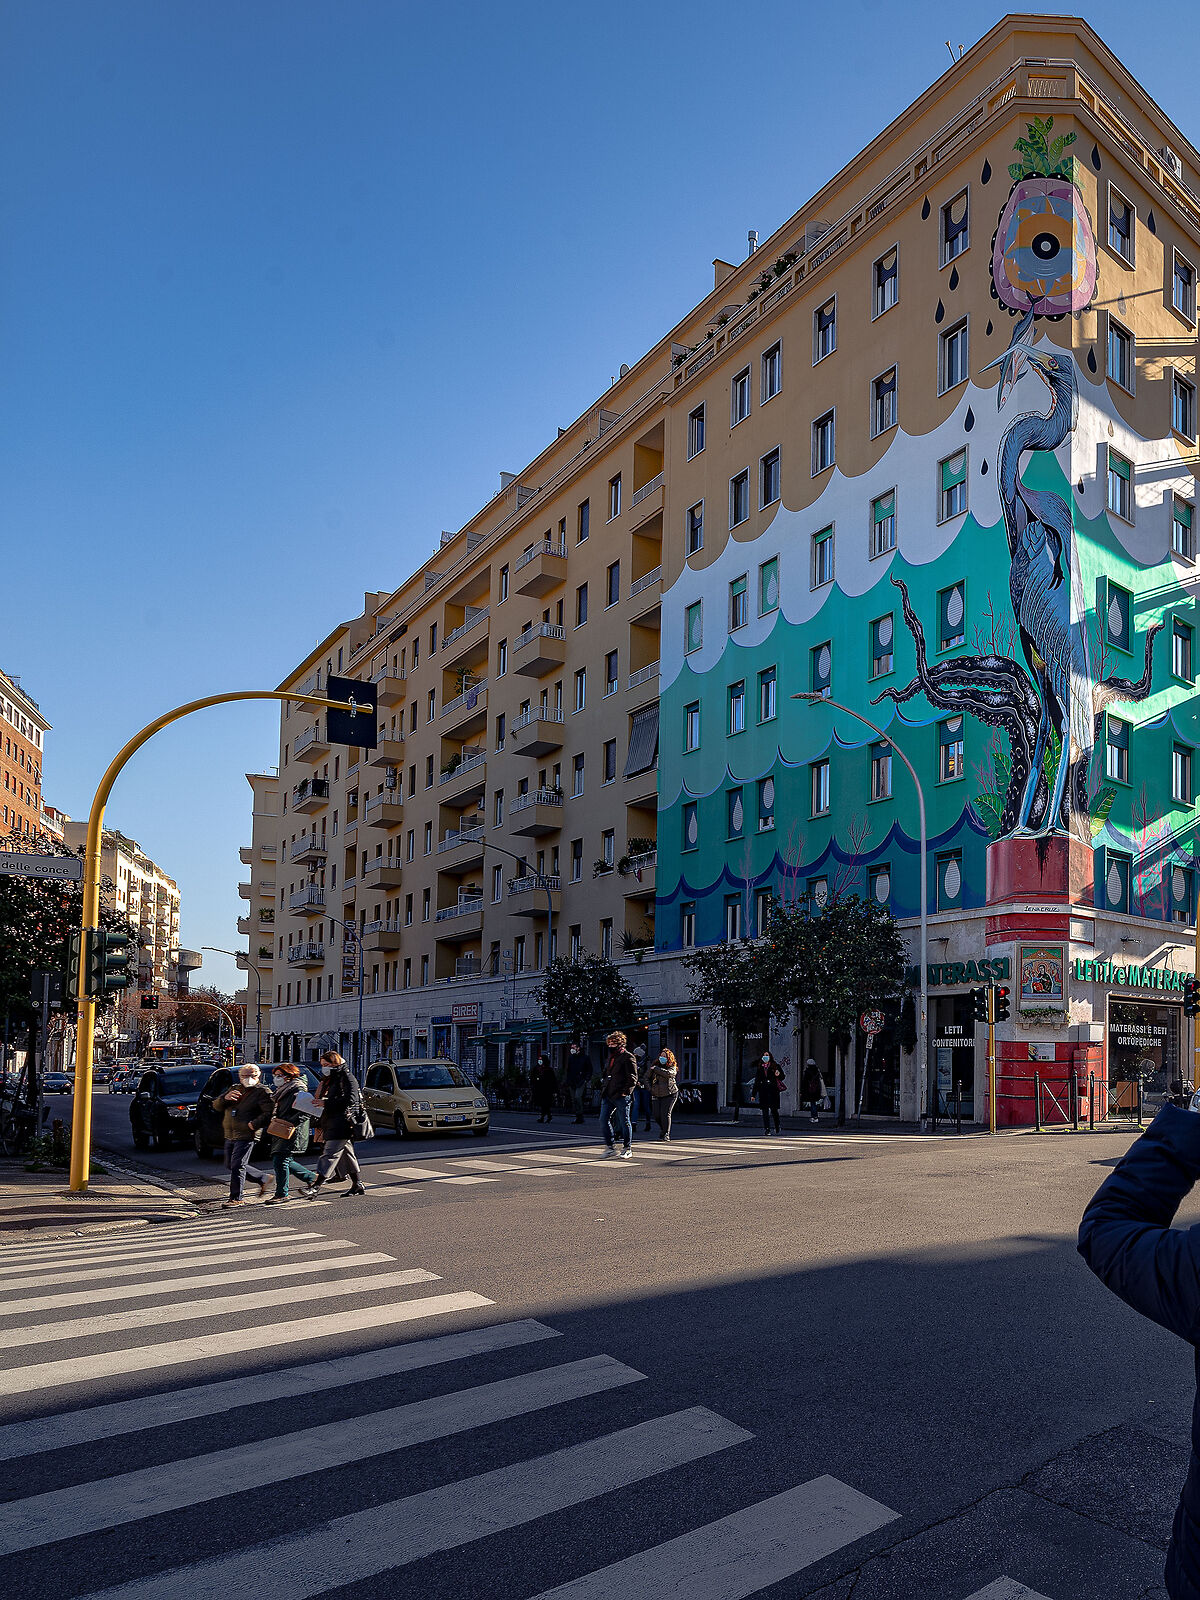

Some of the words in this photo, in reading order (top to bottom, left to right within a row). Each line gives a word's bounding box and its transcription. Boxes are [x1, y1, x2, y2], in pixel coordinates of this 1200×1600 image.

[1, 861, 31, 871] delle
[35, 865, 70, 875] conce
[343, 920, 356, 978] SIRER
[1076, 957, 1114, 983] LETTI
[1117, 967, 1126, 985] e
[1128, 964, 1195, 992] MATERAS
[453, 1003, 478, 1017] SIRER
[944, 1025, 963, 1035] LETTI
[1110, 1023, 1147, 1034] MATERASSI
[1153, 1026, 1168, 1036] RETI
[1117, 1036, 1162, 1047] ORTOPEDICHE
